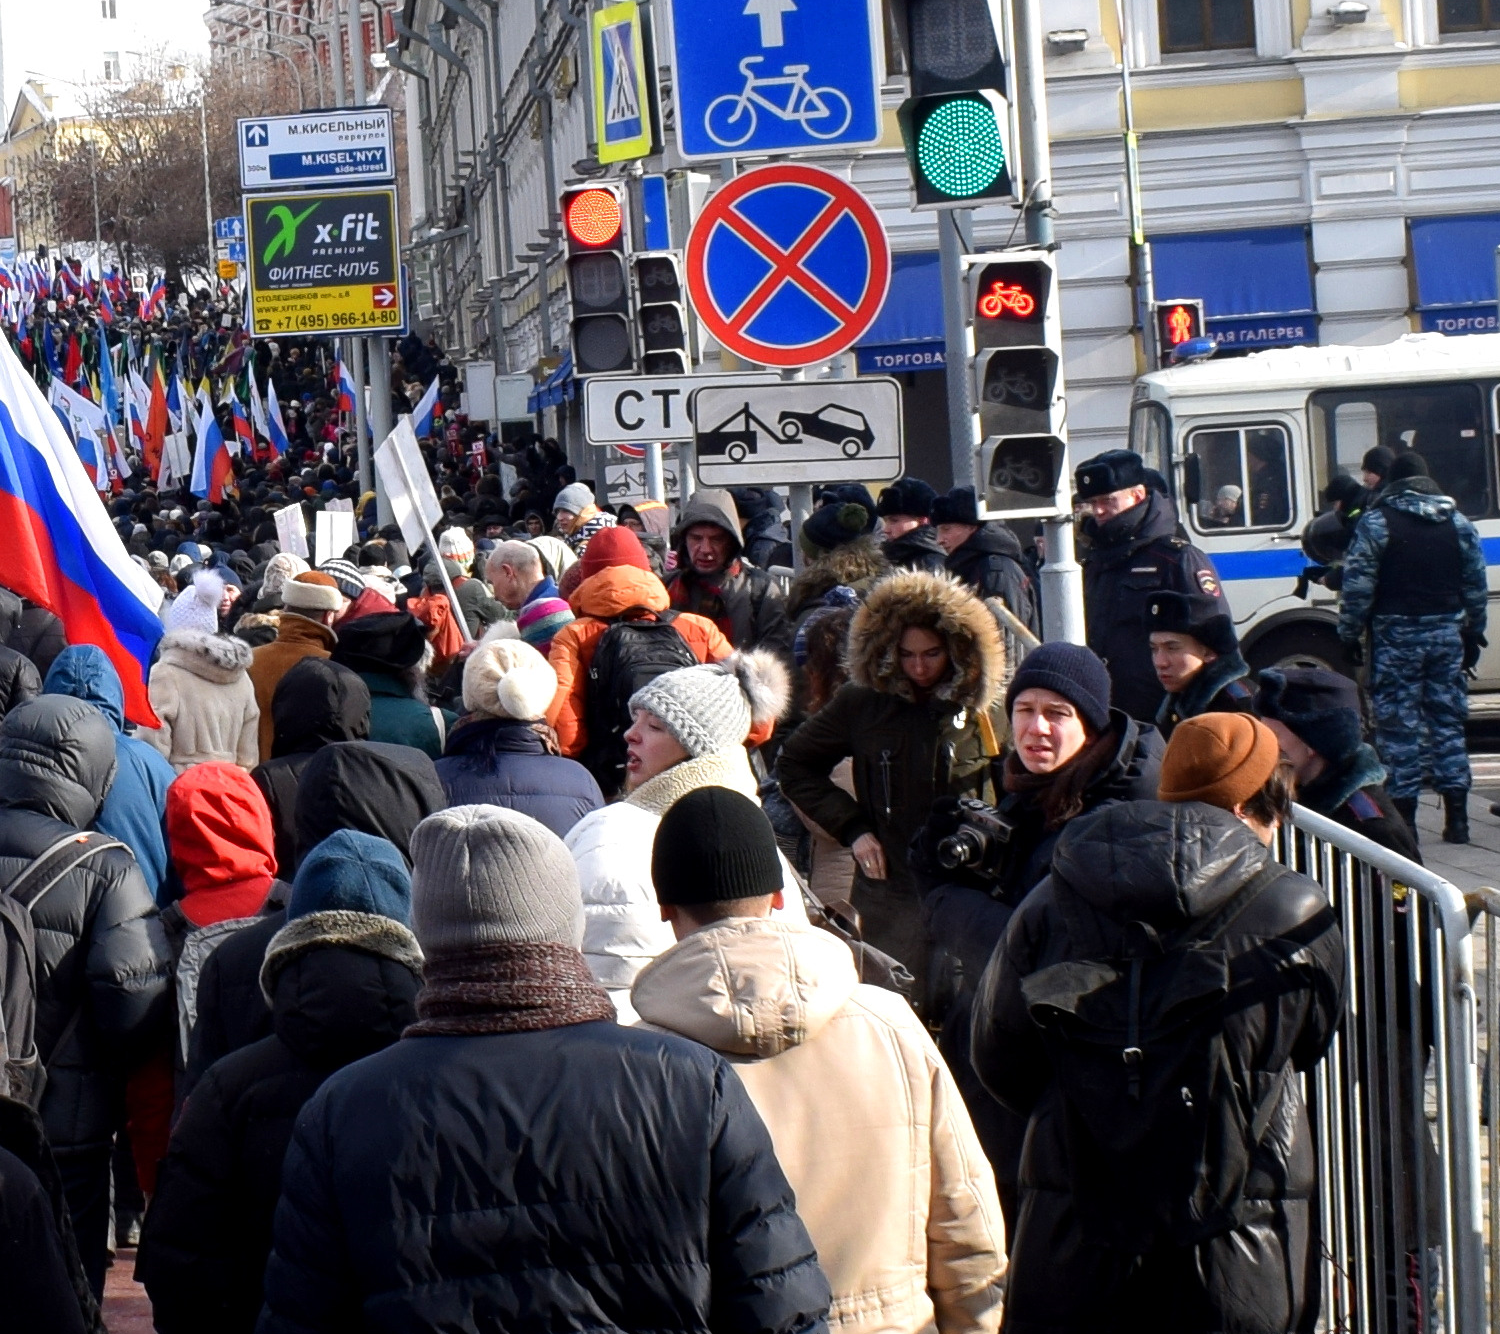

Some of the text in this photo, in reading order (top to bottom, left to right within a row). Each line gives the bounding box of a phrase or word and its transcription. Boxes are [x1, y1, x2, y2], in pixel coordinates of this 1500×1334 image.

[312, 246, 366, 257] PREMIUM
[268, 261, 380, 281] ФИТНЕС-КЛУБ
[276, 310, 397, 330] +7 (495) 966-14-80
[1239, 326, 1304, 342] ГАЛЕРЕЯ
[873, 352, 946, 368] ТОРГОВА
